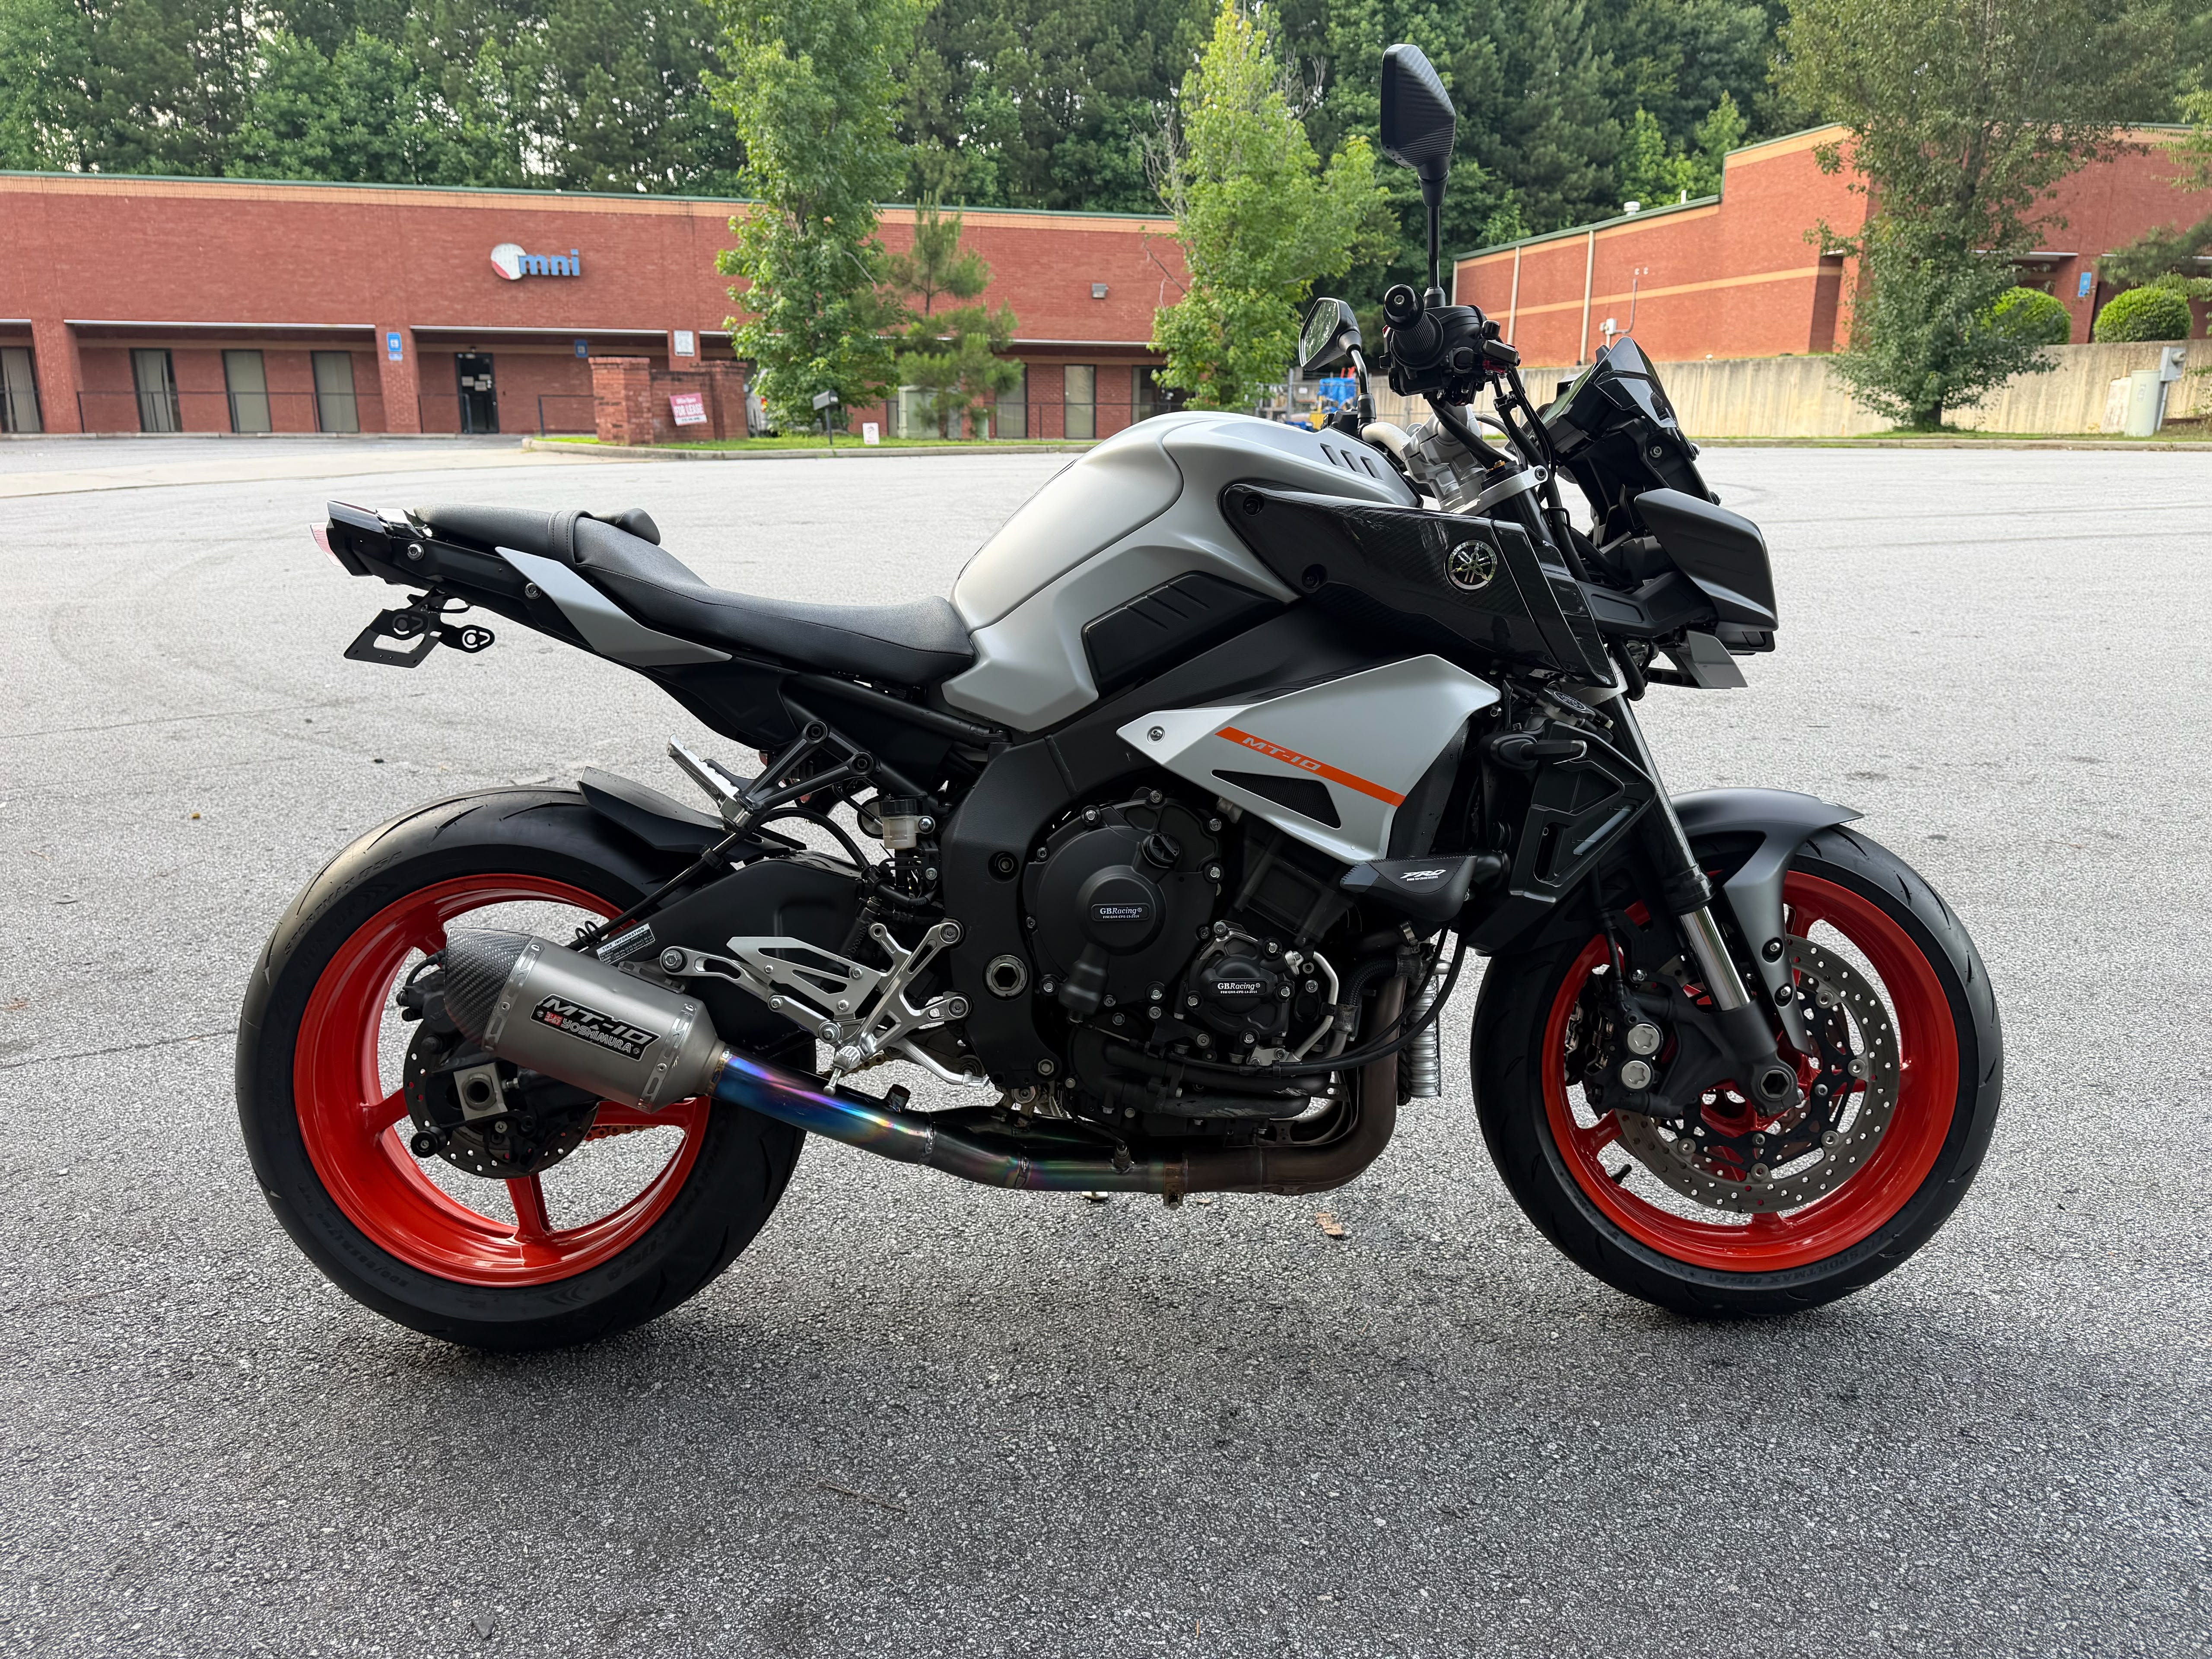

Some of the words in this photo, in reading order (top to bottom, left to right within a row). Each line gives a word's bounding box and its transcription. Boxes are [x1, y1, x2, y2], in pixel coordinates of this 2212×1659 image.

[1242, 737, 1321, 770] MT-10
[614, 927, 645, 945] INFORMATION
[542, 998, 652, 1044] MT-10
[561, 1017, 632, 1054] YOSHIMURA
[1769, 1249, 1860, 1283] SPORTMAX
